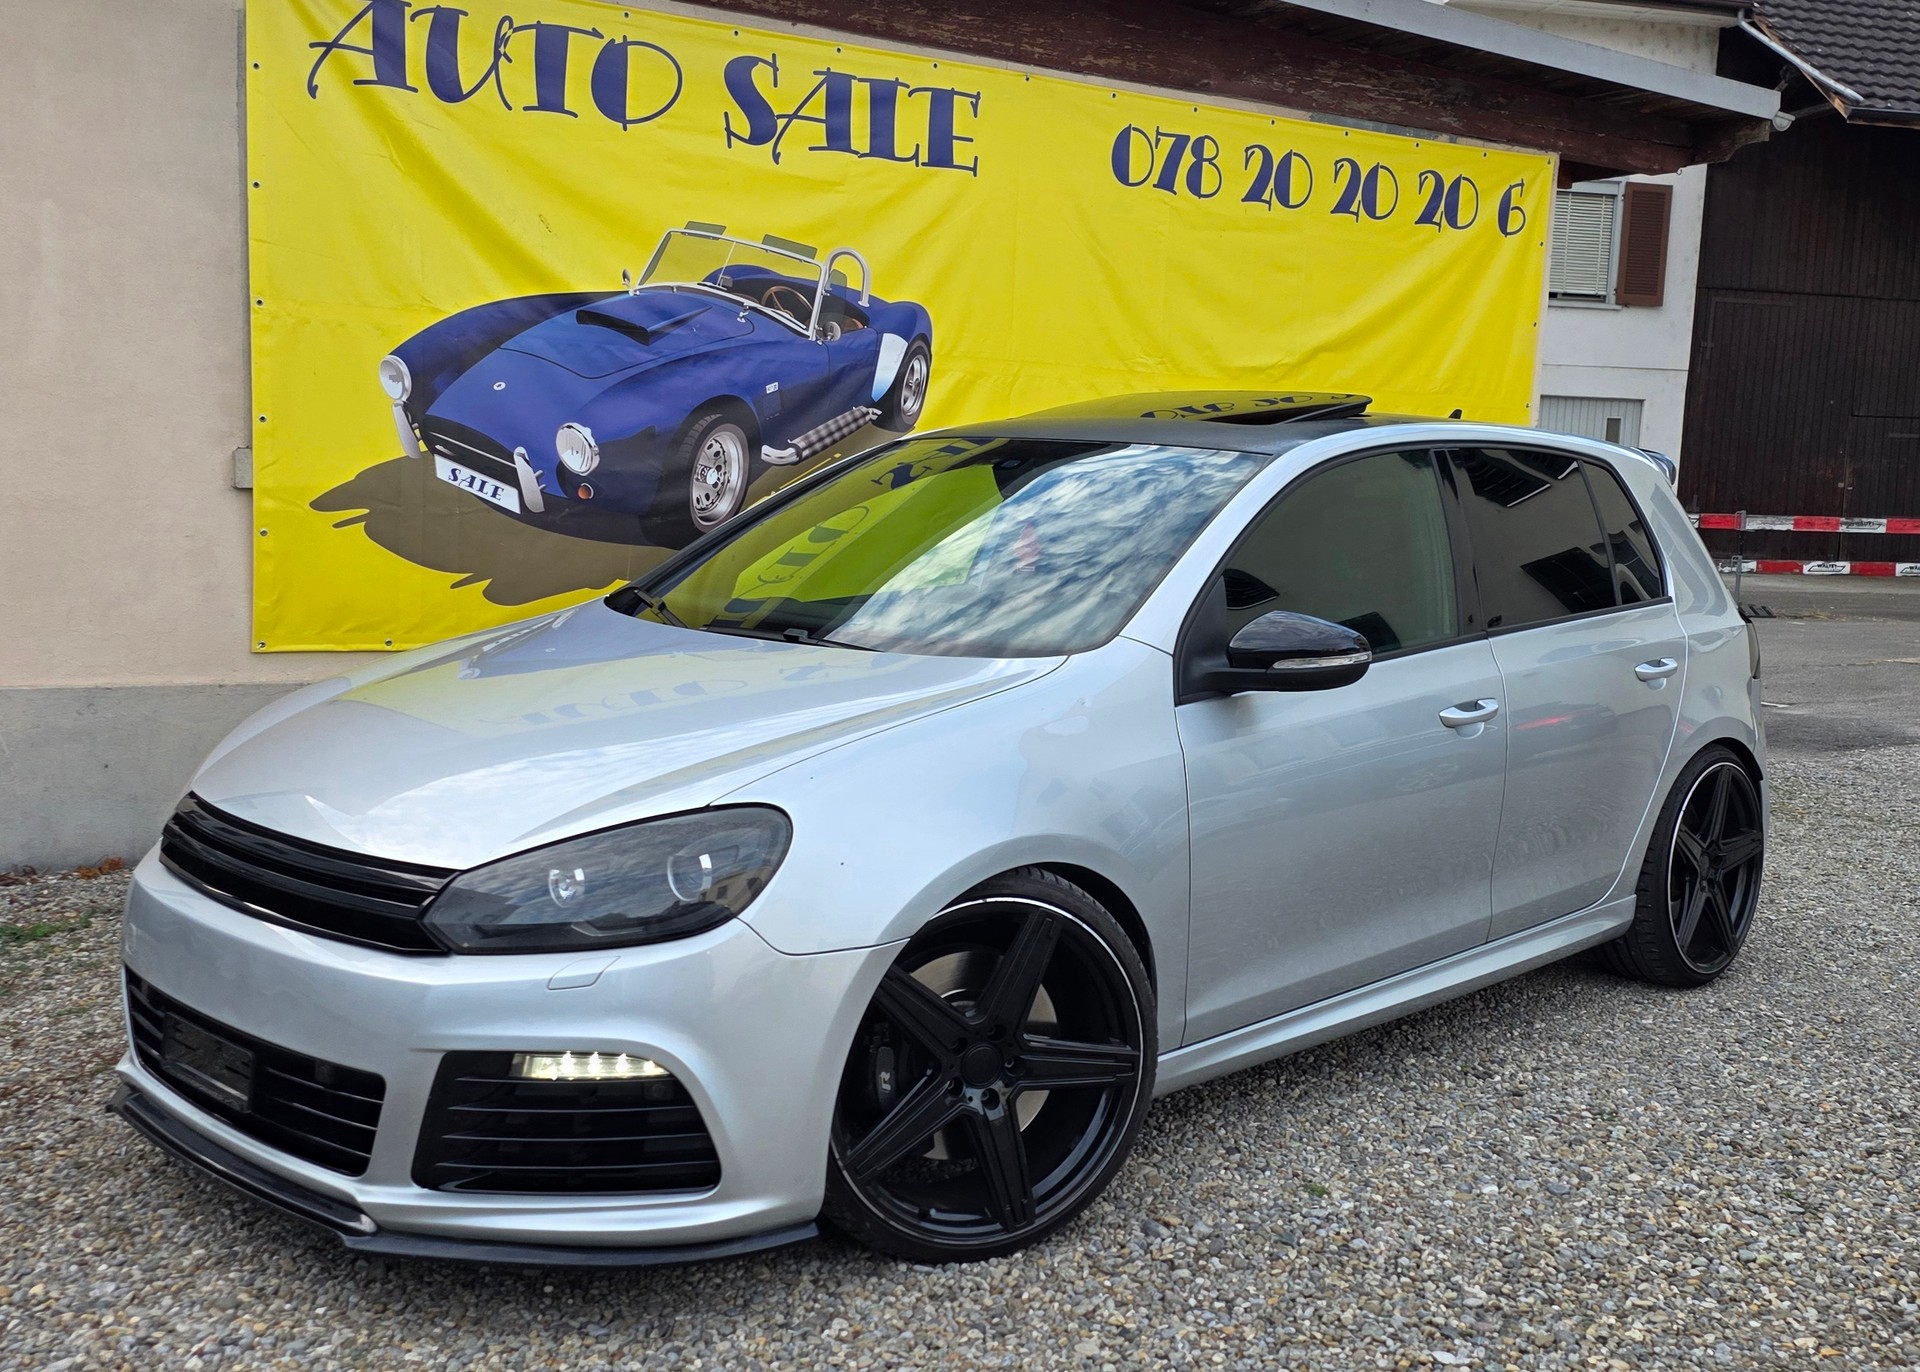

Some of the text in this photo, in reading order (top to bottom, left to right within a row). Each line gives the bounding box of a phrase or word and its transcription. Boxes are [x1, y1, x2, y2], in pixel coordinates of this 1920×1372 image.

[307, 0, 981, 177] AUTO SALE
[1111, 123, 1526, 238] 078 20 20 20 6
[448, 467, 504, 501] SALE
